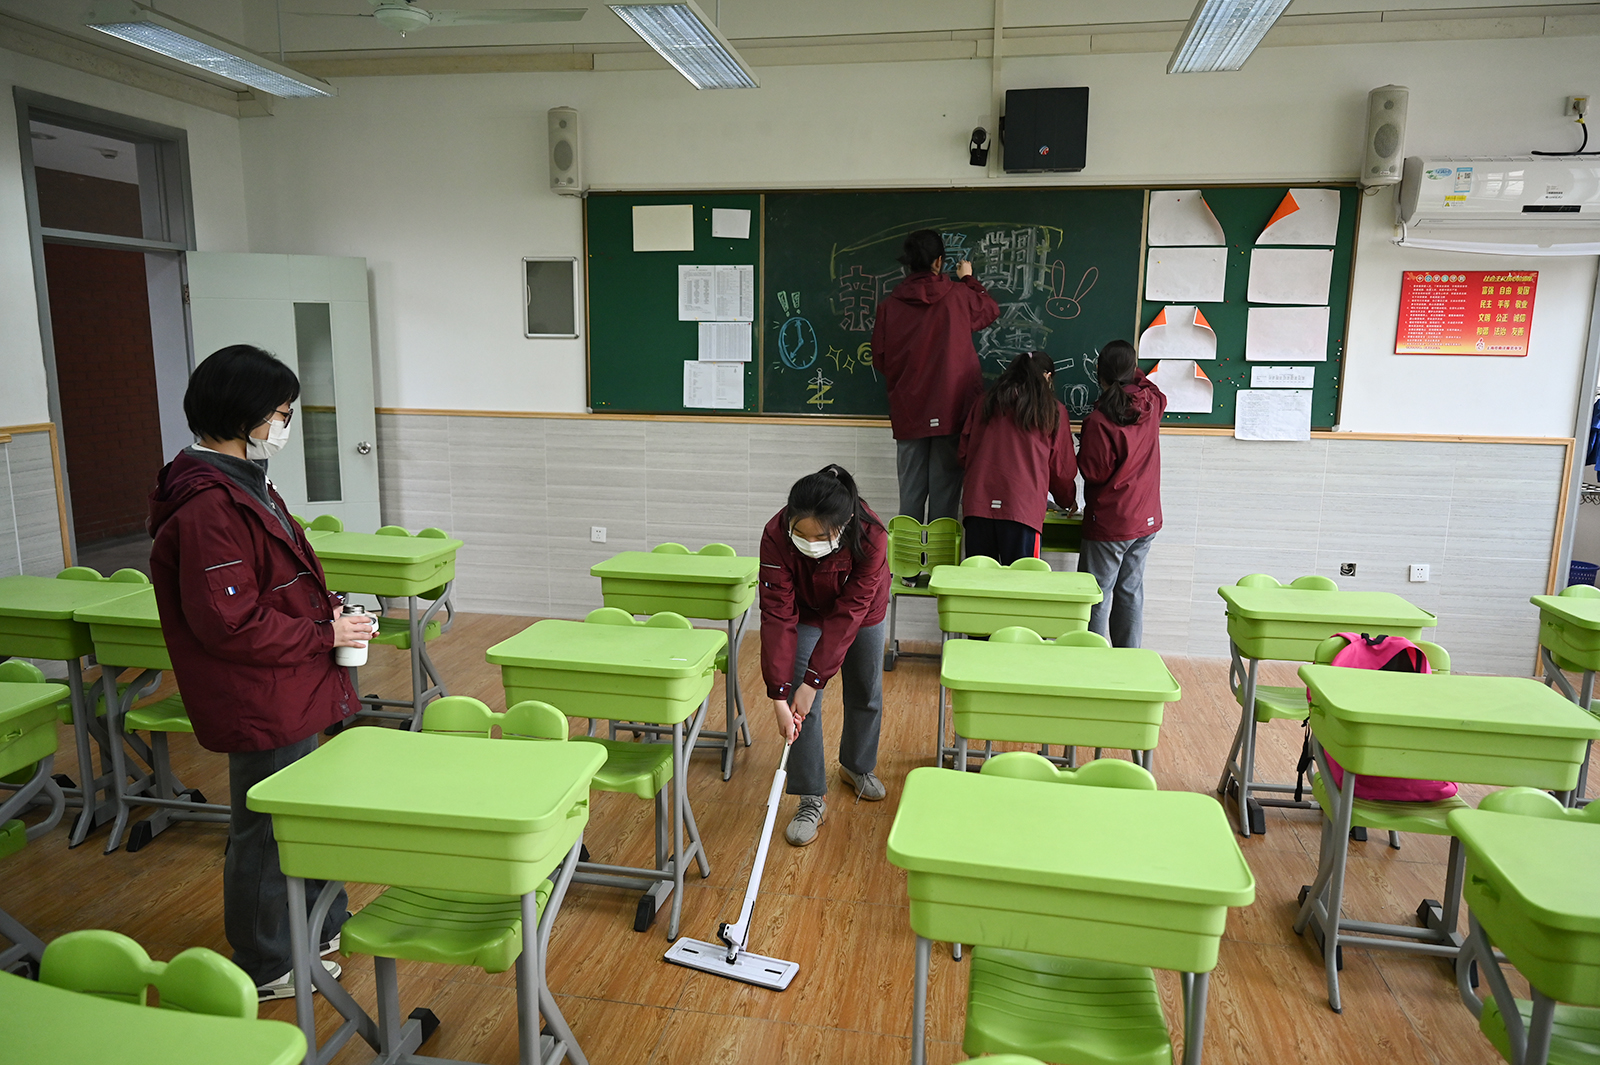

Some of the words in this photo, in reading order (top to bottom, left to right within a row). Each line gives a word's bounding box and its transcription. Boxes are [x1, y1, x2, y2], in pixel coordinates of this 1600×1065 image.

[1481, 286, 1494, 295] 富强
[1499, 286, 1512, 295] 自由
[1517, 286, 1530, 295] 爱国
[1480, 300, 1493, 309] 民主
[1497, 300, 1510, 309] 平等
[1515, 300, 1528, 309] 敬业
[1478, 313, 1491, 322] 文明
[1496, 313, 1508, 322] 公正
[1513, 313, 1526, 322] 诚信
[1494, 327, 1507, 336] 法治
[1511, 327, 1524, 336] 友善
